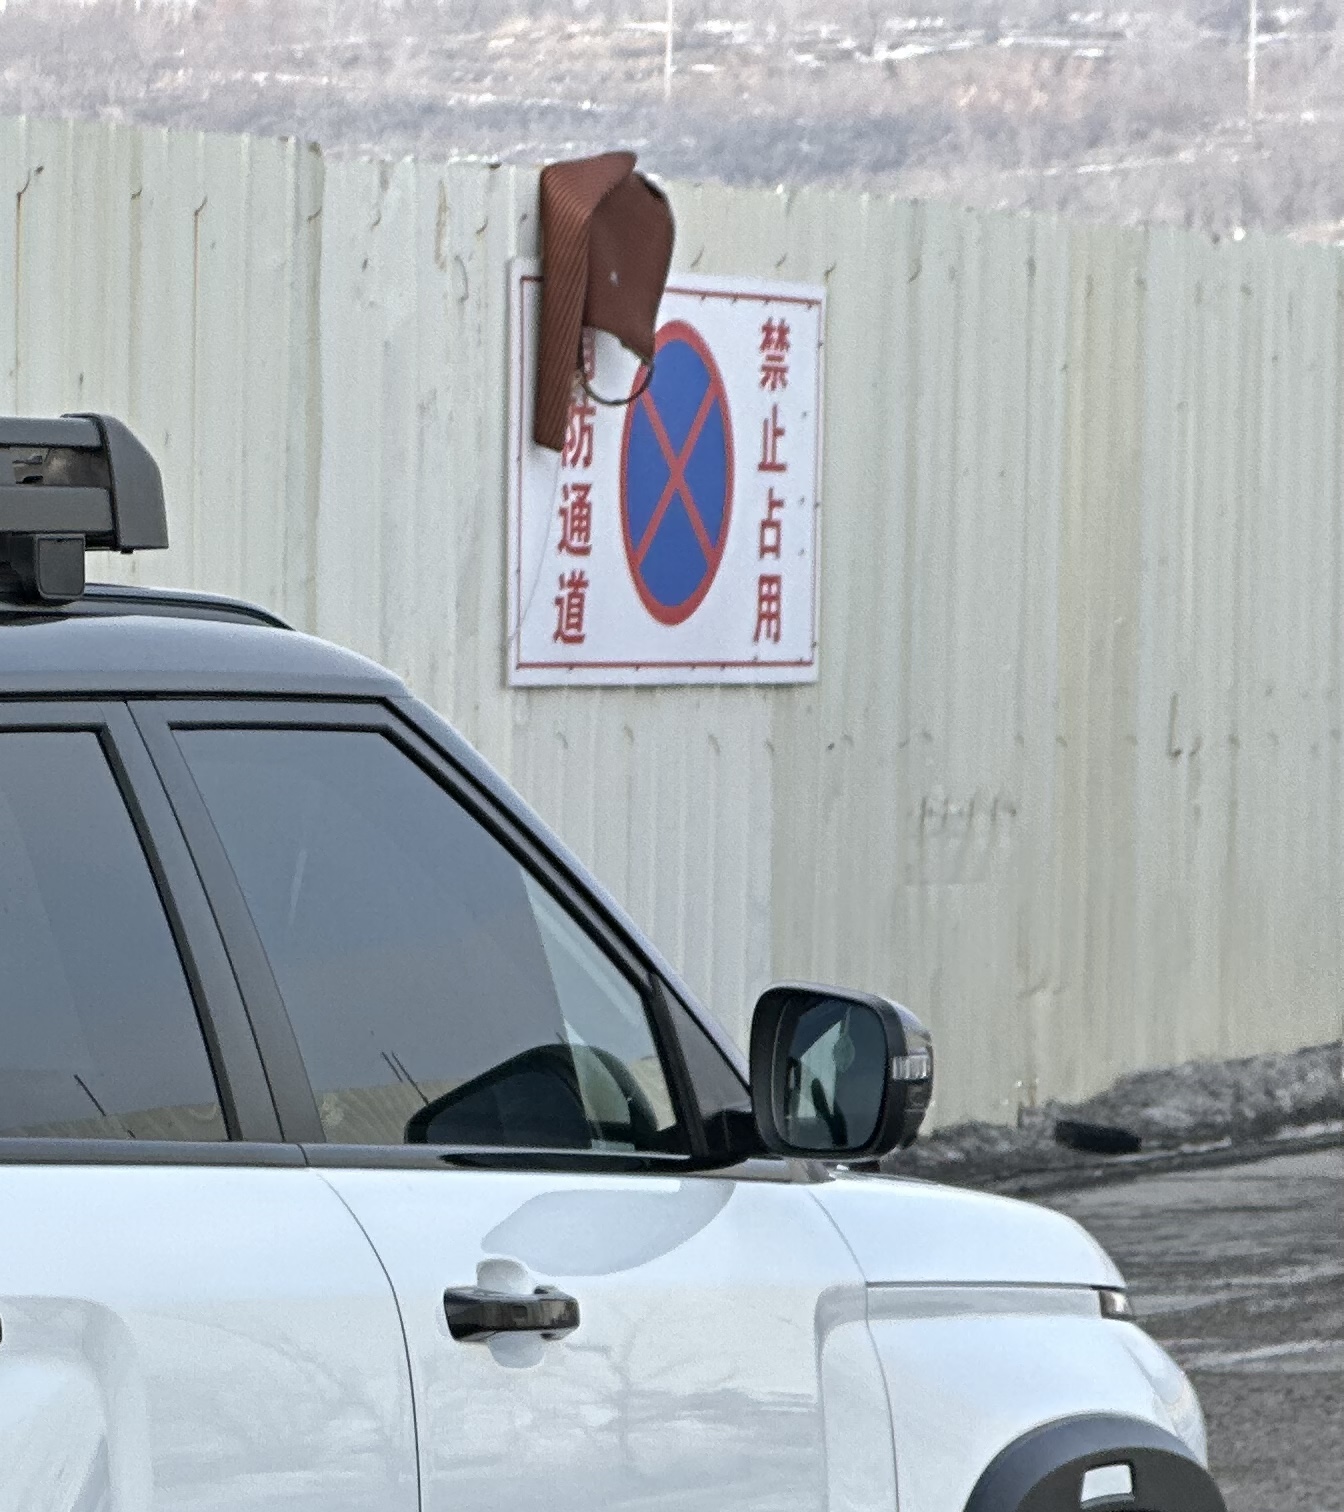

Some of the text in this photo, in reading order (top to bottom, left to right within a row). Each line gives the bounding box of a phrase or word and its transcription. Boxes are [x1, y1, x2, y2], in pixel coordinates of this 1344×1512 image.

[552, 326, 597, 645] 防通道
[753, 316, 790, 645] 禁止占用
